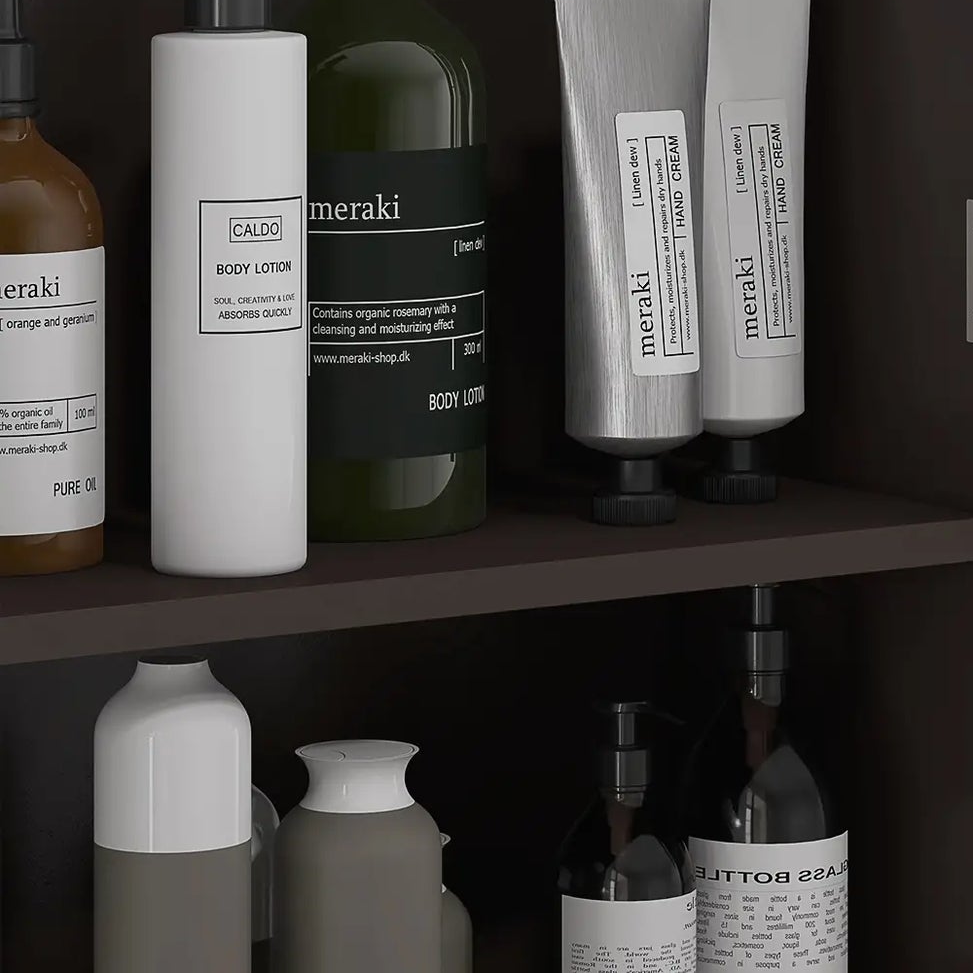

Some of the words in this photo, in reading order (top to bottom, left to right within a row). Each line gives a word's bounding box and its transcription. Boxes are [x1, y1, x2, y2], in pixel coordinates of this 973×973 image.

[733, 134, 743, 156] dew
[770, 123, 784, 168] CREAM
[629, 146, 639, 168] dew
[668, 135, 682, 182] CREAM
[757, 146, 767, 172] hands
[654, 158, 664, 185] hands
[736, 158, 745, 186] Linen
[760, 174, 768, 188] dry
[632, 170, 641, 199] Linen
[658, 187, 666, 202] dry
[776, 177, 787, 213] HAND
[308, 193, 400, 220] meraki
[674, 190, 685, 227] HAND
[763, 190, 771, 219] repairs
[659, 203, 669, 233] repairs
[232, 223, 280, 237] CALDO
[765, 221, 773, 238] and
[661, 235, 670, 252] and
[216, 263, 250, 275] BODY
[255, 260, 292, 274] LOTION
[0, 276, 60, 299] eraki
[664, 254, 674, 304] moisturizes
[735, 255, 759, 340] meraki
[218, 309, 260, 320] ABSORBS
[262, 307, 293, 318] QUICKLY
[312, 307, 353, 319] Contains
[355, 307, 391, 321] organic
[392, 305, 433, 318] rosemary
[434, 302, 450, 315] with
[451, 304, 457, 313] a
[631, 271, 656, 358] meraki
[6, 319, 41, 331] orange
[44, 316, 60, 326] and
[312, 323, 356, 338] cleansing
[358, 323, 377, 335] and
[379, 321, 432, 335] moisturizing
[433, 318, 455, 331] effect
[313, 350, 411, 365] www.meraki-shop.dk
[429, 390, 460, 411] BODY
[11, 407, 42, 419] organic
[44, 406, 54, 416] oil
[74, 408, 86, 419] 100
[14, 421, 39, 431] entire
[41, 418, 63, 429] family
[53, 480, 80, 497] PURE
